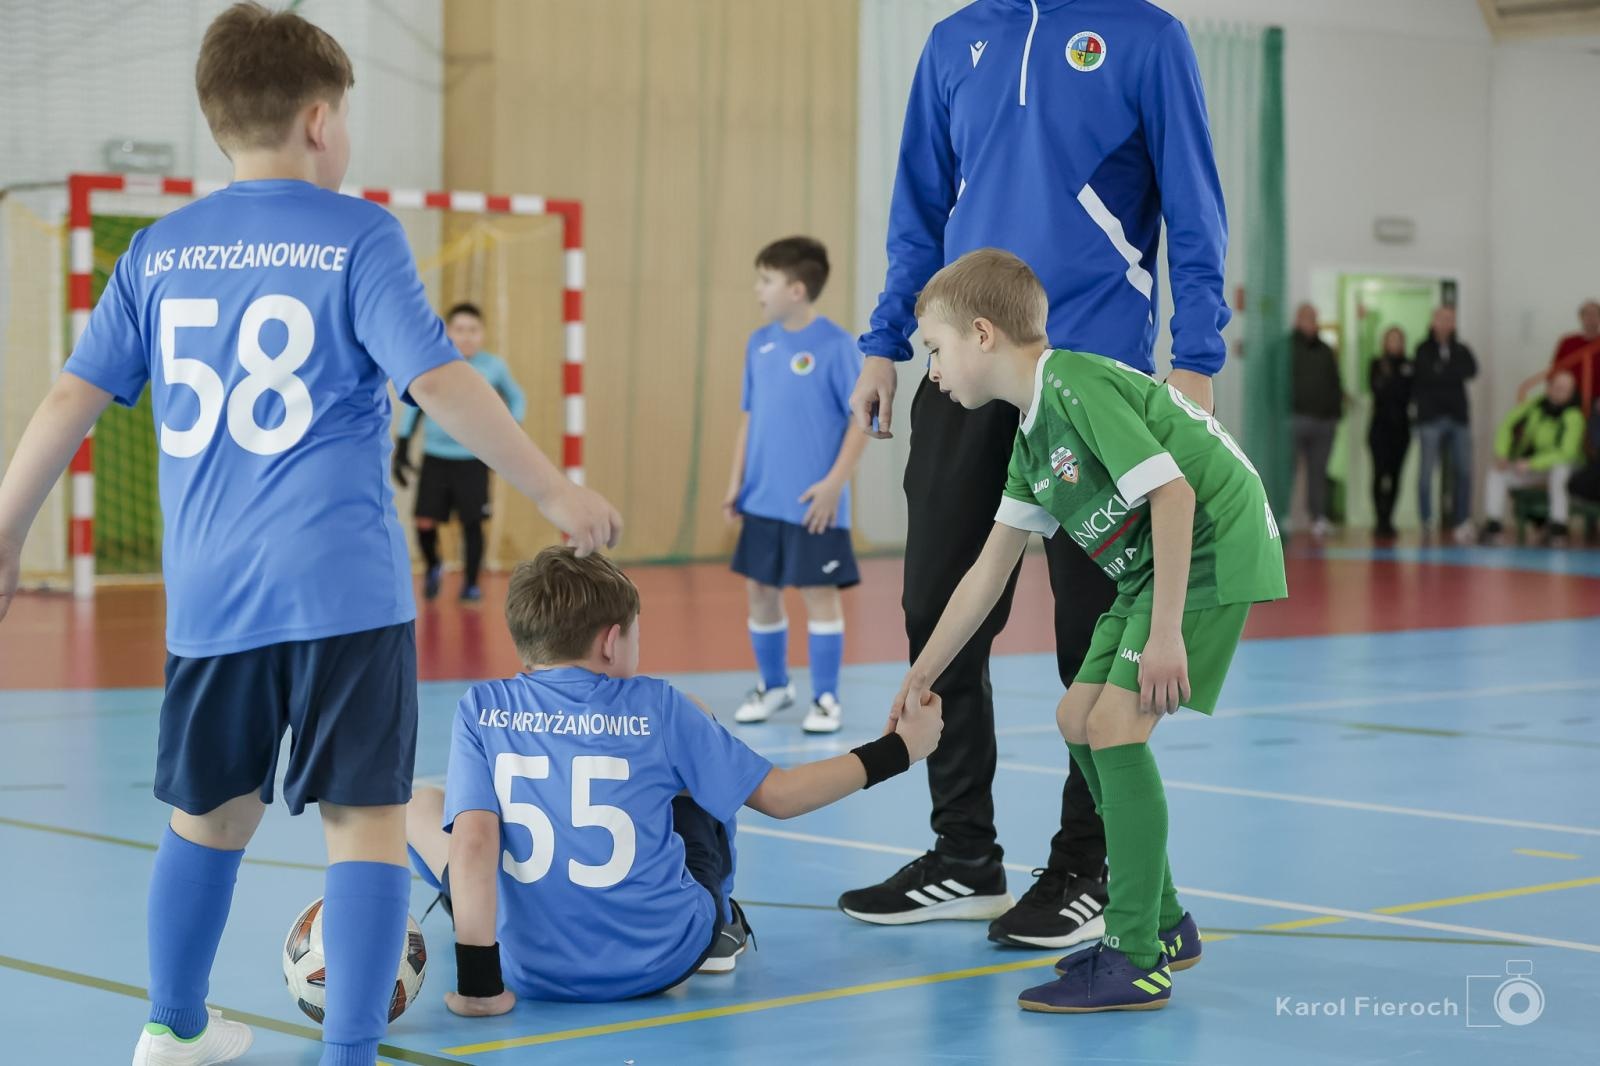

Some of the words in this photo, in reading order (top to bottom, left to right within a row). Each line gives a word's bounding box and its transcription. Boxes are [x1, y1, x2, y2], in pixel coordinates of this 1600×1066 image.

[145, 248, 176, 277] LKS
[178, 240, 348, 272] KRZYŻANOWICE
[160, 294, 315, 458] 58
[1070, 494, 1131, 548] NICKI
[1121, 647, 1142, 664] JAK
[479, 708, 510, 728] LKS
[511, 710, 651, 736] KRZYŻANOWICE
[494, 753, 636, 888] 55
[1102, 933, 1120, 949] KO
